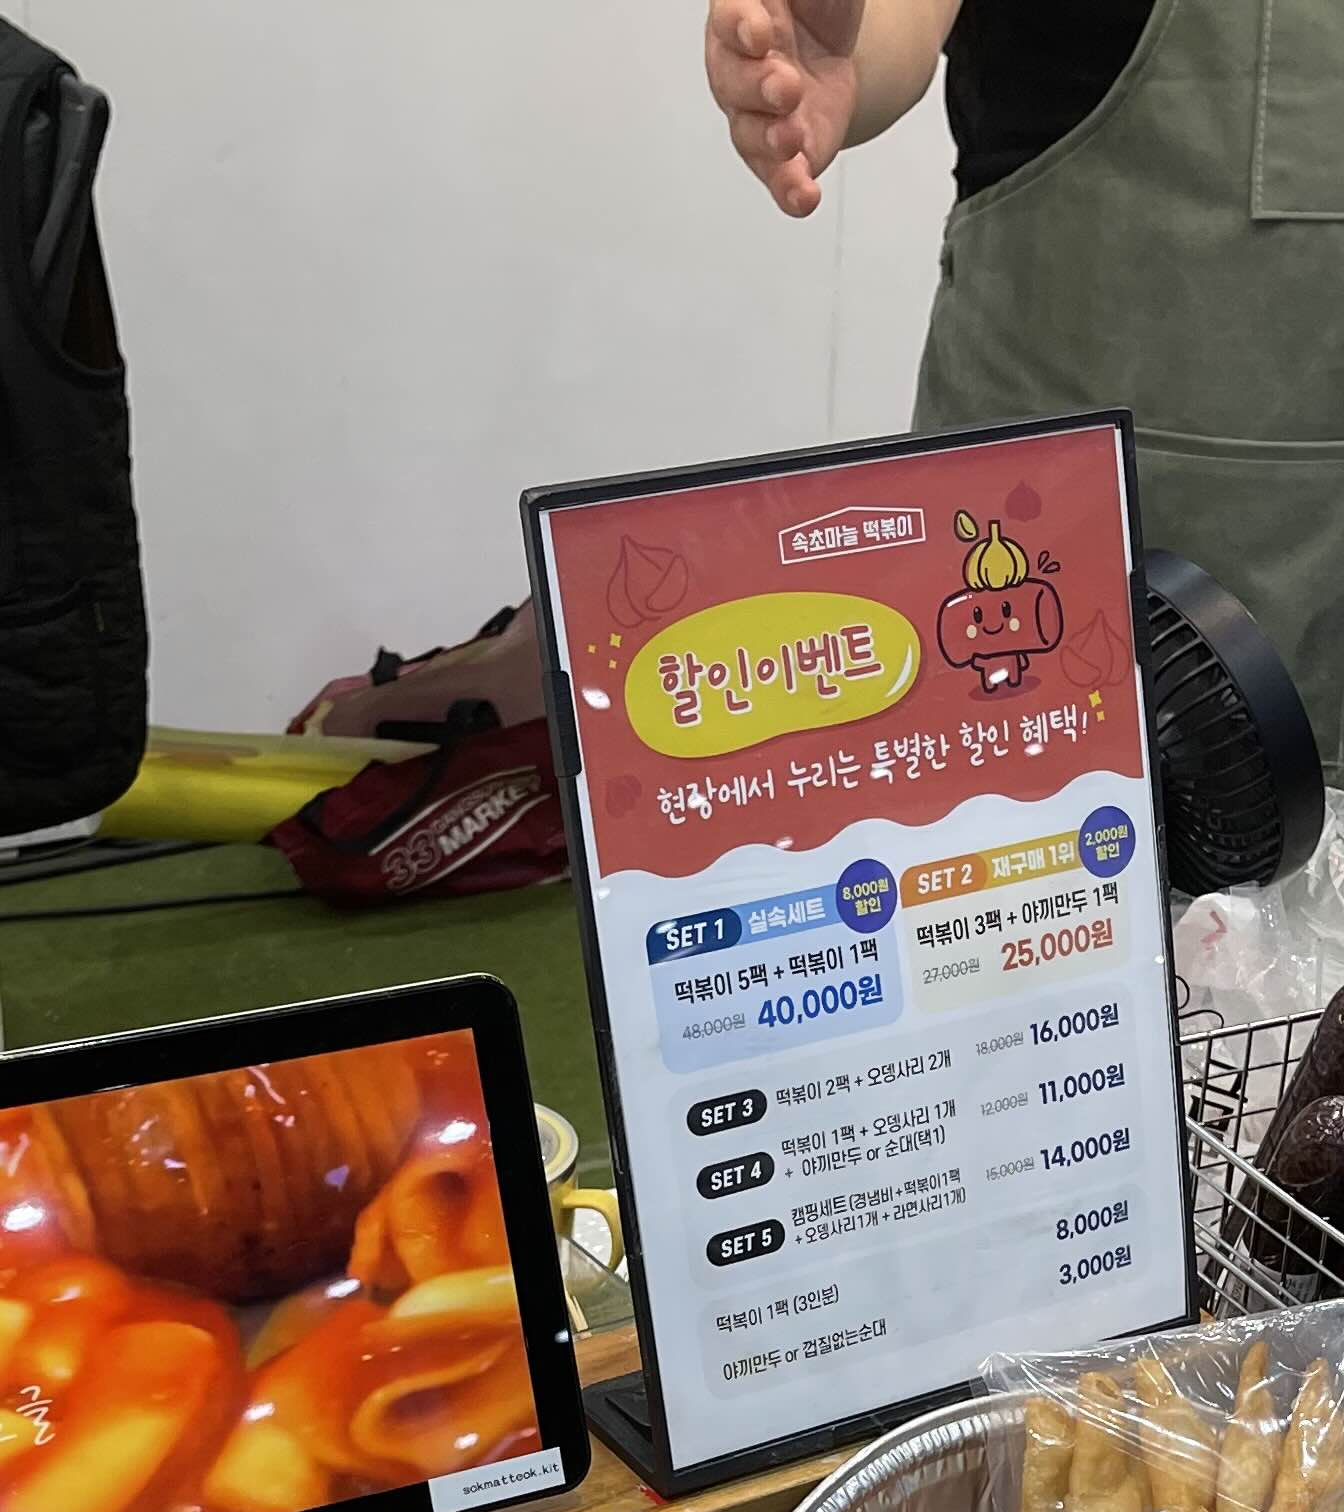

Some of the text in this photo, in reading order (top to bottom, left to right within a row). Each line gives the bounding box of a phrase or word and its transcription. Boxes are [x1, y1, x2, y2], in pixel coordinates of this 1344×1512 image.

[791, 514, 913, 554] 속초마늘 떡볶이
[657, 623, 885, 729] 할인이벤트
[656, 768, 776, 826] 현장에서
[787, 751, 863, 799] 누리는
[871, 731, 951, 785] 특별한
[958, 720, 1011, 767] 할인
[917, 867, 956, 895] SET
[960, 863, 974, 886] 2
[666, 897, 827, 951] SET 1 실속세트
[916, 916, 971, 950] 떡볶이
[974, 908, 1003, 936] 3팩
[1022, 888, 1088, 925] 야끼만두
[1093, 881, 1120, 908] 1팩
[675, 971, 733, 1006] 떡볶이
[738, 963, 770, 992] 5팩
[788, 946, 845, 980] 떡볶이
[849, 938, 880, 966] 1팩
[1000, 918, 1114, 971] 25,000원
[757, 973, 885, 1029] 40,000원
[701, 1101, 737, 1128] SET
[741, 1098, 754, 1118] 3
[776, 1080, 823, 1108] 떡볶이
[825, 1073, 852, 1097] 2팩
[867, 1055, 926, 1087] 오뎅사리
[928, 1049, 953, 1072] 2개
[1029, 1003, 1120, 1045] 16,000원
[781, 1132, 828, 1158] 떡볶이
[831, 1125, 857, 1147] 1팩
[872, 1106, 931, 1138] 오뎅사리
[934, 1099, 957, 1121] 1개
[1038, 1063, 1127, 1105] 11,000원
[711, 1160, 762, 1192] SET 4
[801, 1148, 862, 1177] 야끼만두
[866, 1147, 882, 1161] or
[1040, 1127, 1132, 1171] 14,000원
[720, 1228, 773, 1259] SET 5
[766, 1298, 790, 1320] 1팩
[793, 1283, 840, 1314] (3인분)
[1056, 1200, 1130, 1241] 8,000원
[722, 1349, 782, 1382] 야끼만두
[785, 1349, 800, 1363] or
[1059, 1245, 1133, 1286] 3,000원
[462, 1463, 560, 1496] sokmatteok.kit
